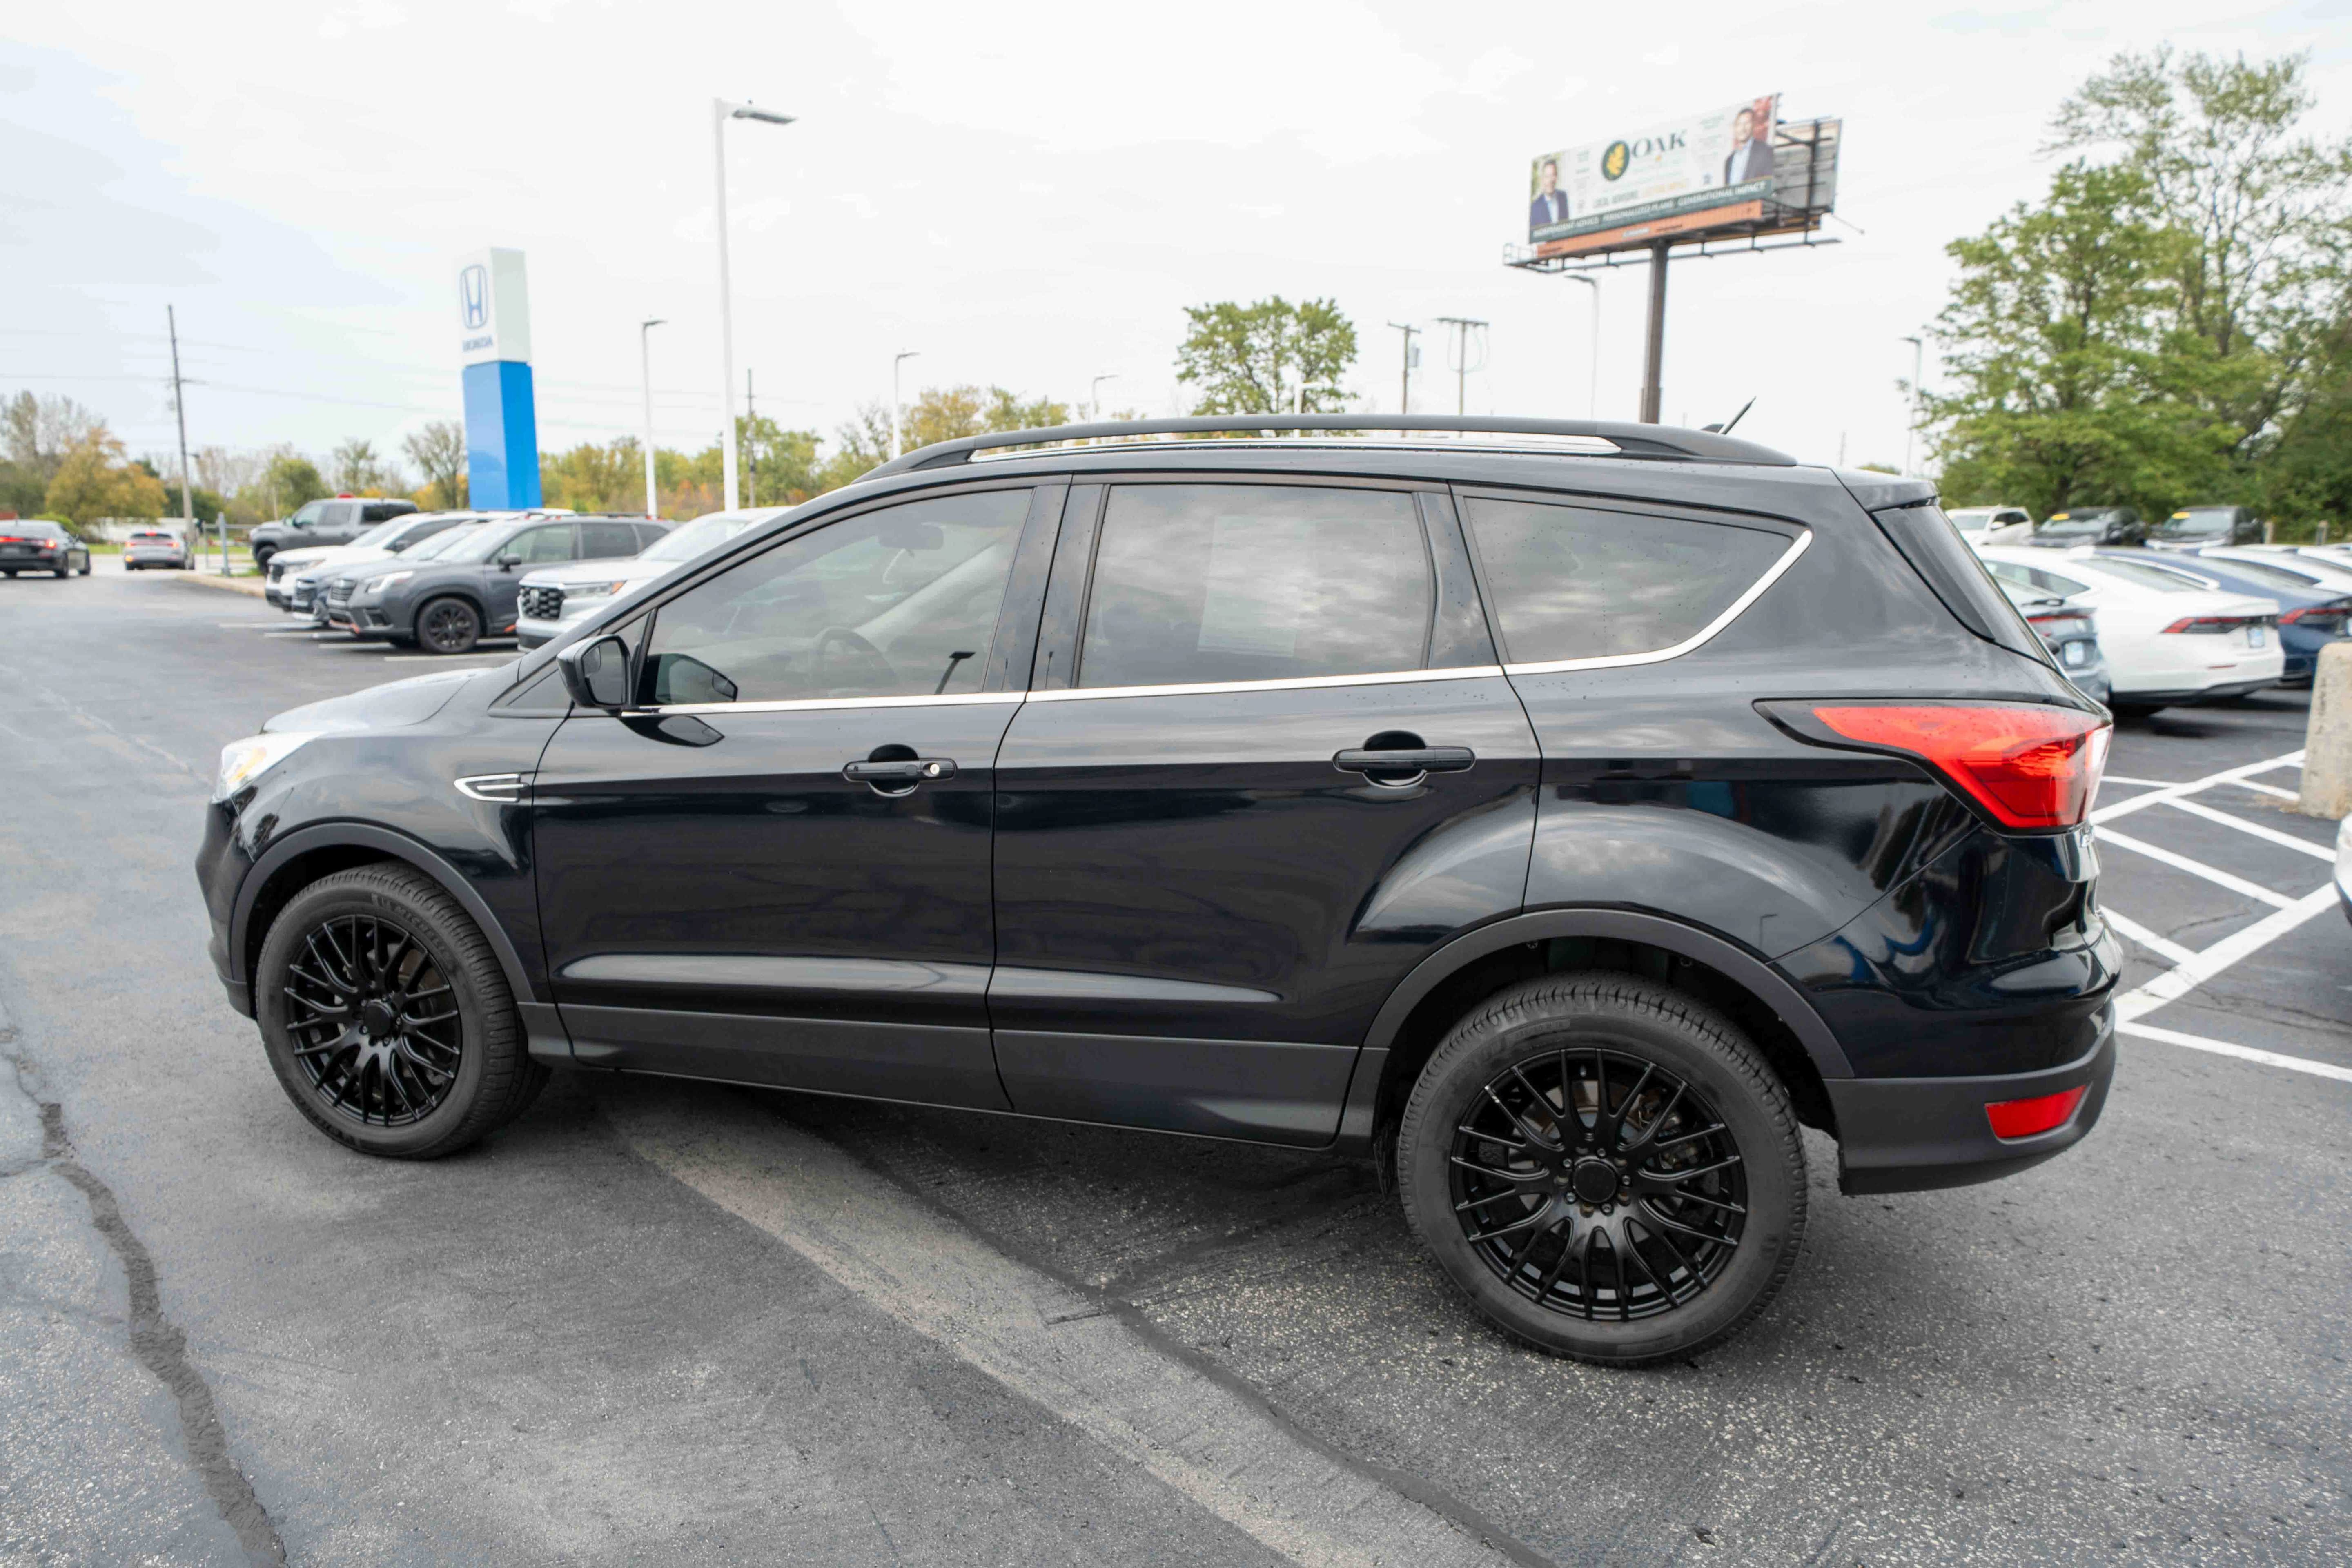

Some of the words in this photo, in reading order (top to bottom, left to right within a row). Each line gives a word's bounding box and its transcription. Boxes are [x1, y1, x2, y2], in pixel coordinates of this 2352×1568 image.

[1632, 129, 1688, 157] OAK
[1677, 189, 1732, 206] GENERATIONAL
[1735, 181, 1766, 194] IMPACT
